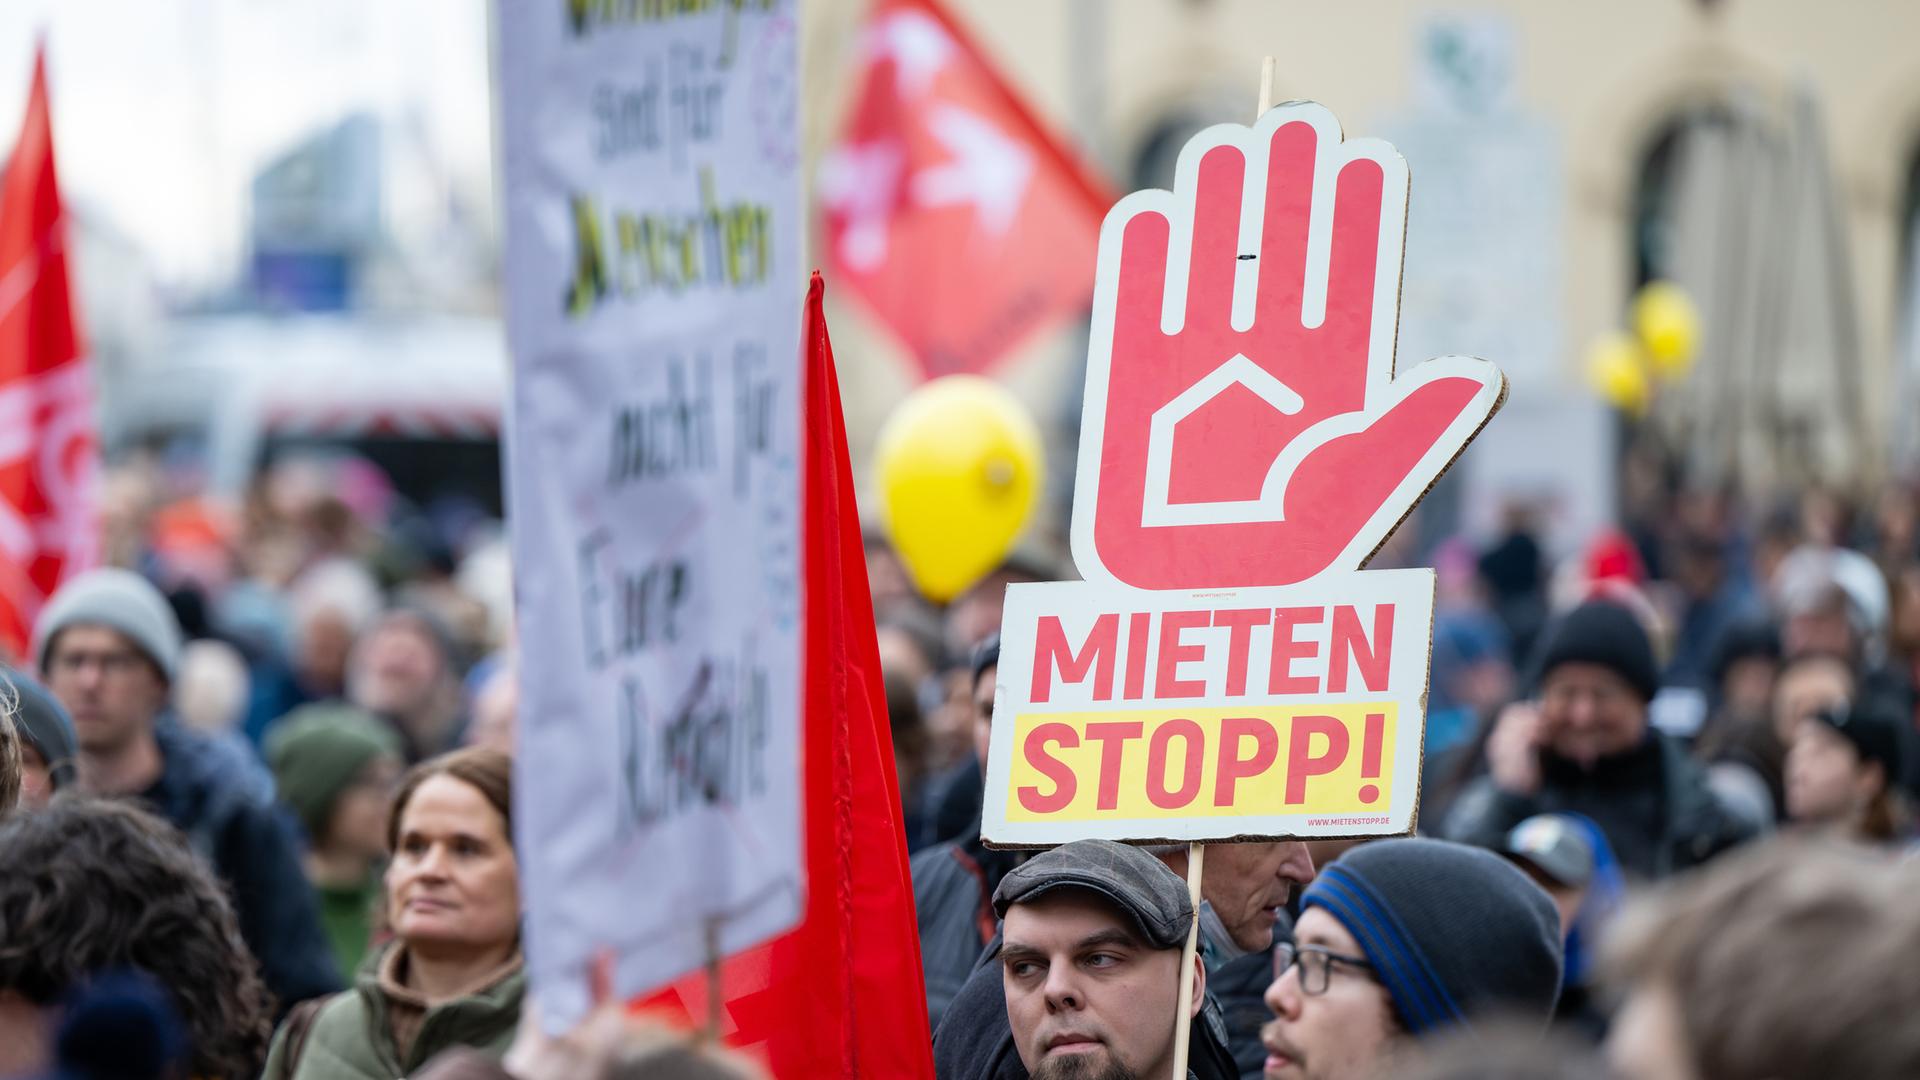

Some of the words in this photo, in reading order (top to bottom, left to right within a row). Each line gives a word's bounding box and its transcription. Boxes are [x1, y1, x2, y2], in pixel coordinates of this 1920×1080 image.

[1030, 603, 1395, 703] MIETEN
[1017, 713, 1386, 813] STOPP!
[1307, 817, 1390, 826] WWW.MIETENSTOPP.DE
